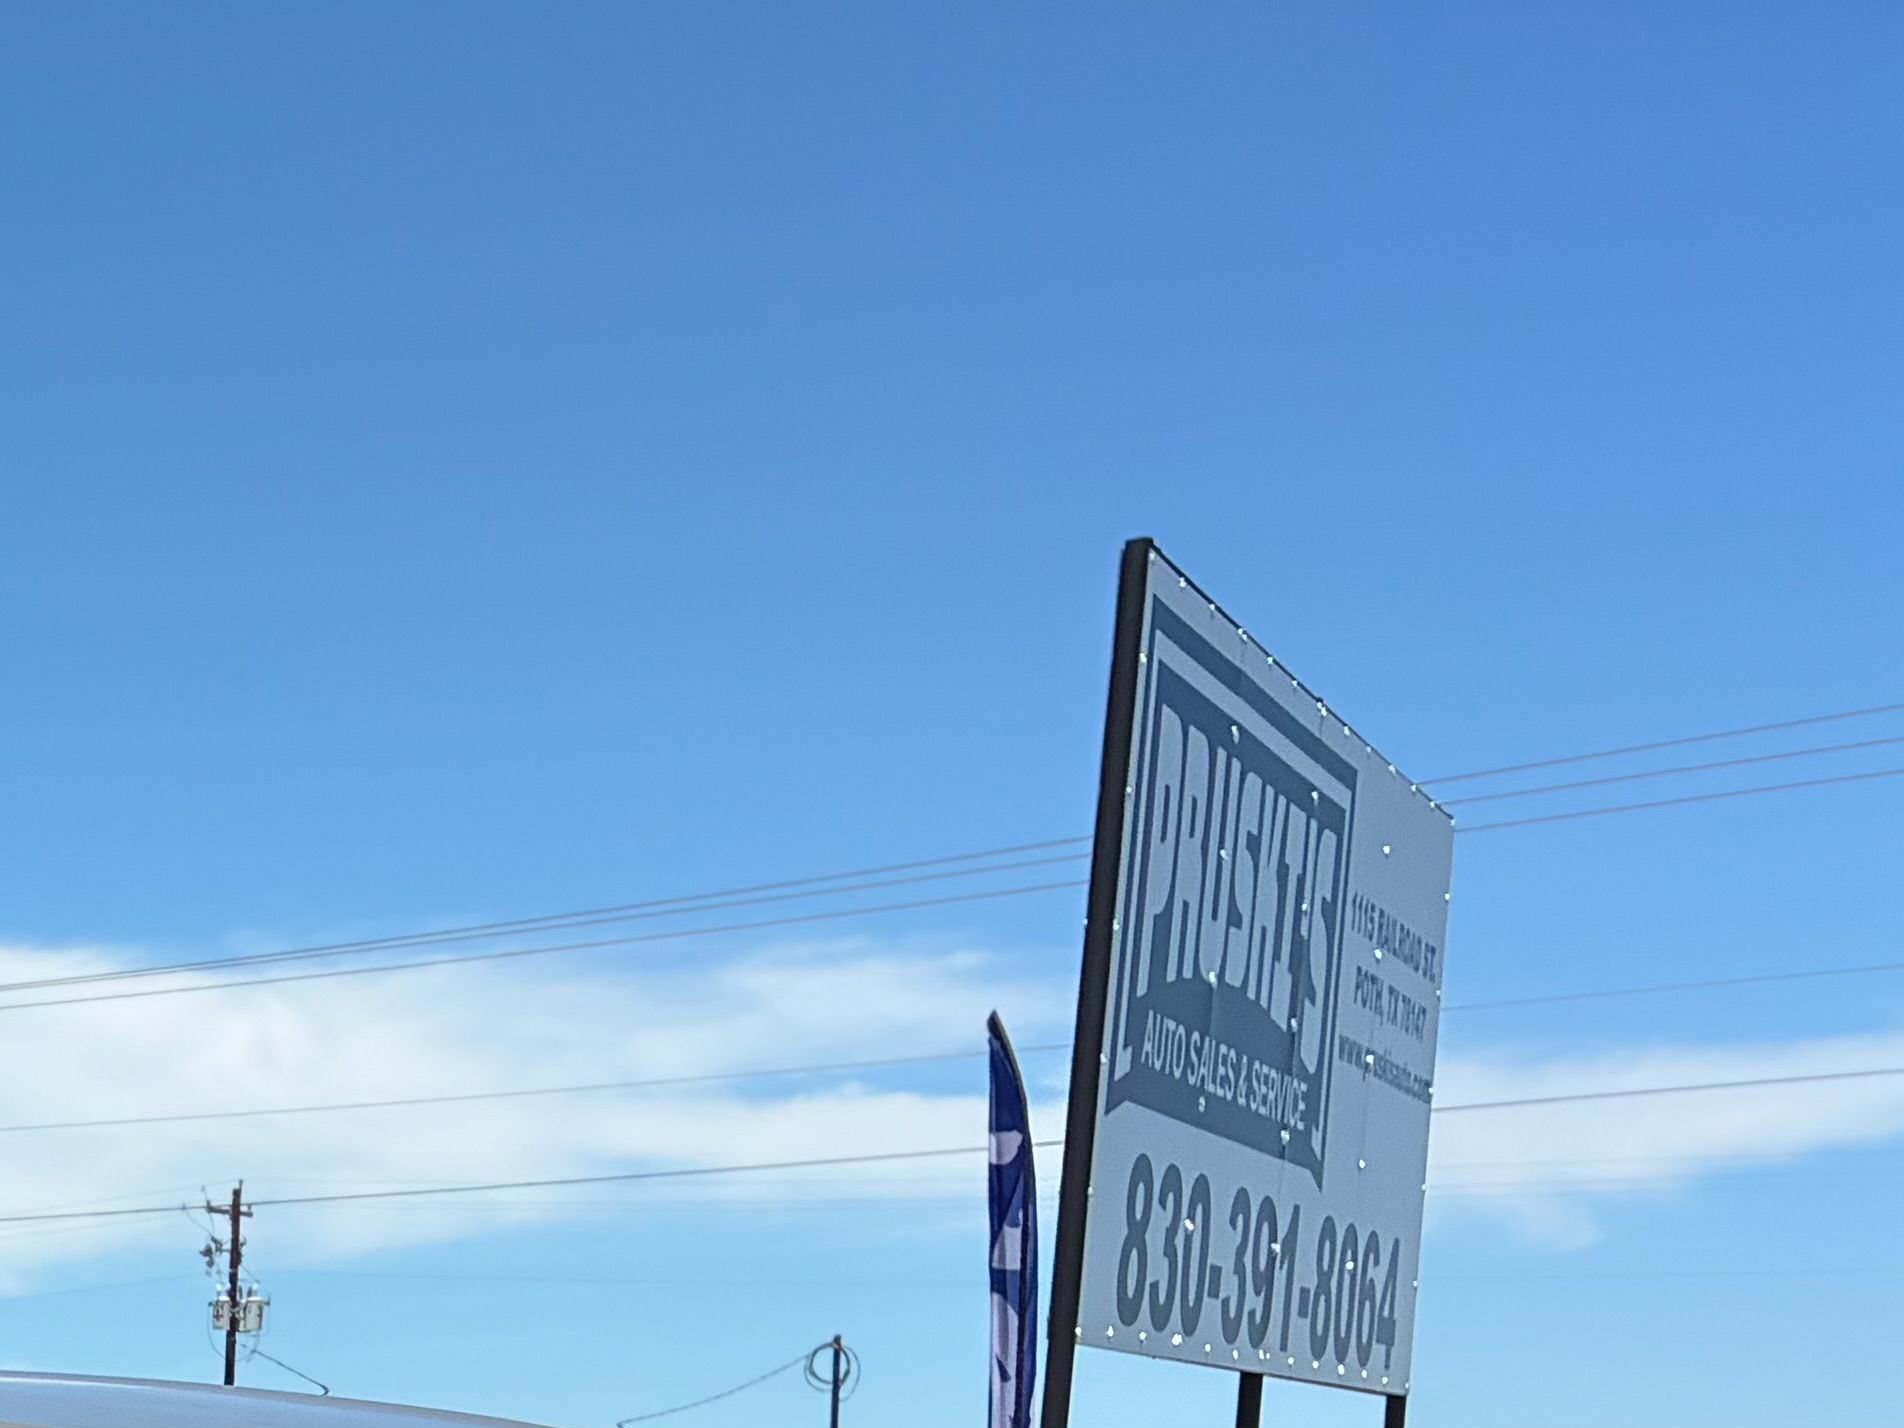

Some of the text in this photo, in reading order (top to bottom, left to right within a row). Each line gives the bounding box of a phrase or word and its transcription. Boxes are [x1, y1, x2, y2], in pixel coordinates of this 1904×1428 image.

[1135, 703, 1338, 1074] PRUSKI'S
[1351, 891, 1376, 942] 1115
[1140, 1009, 1308, 1131] AUTO SALES & SERVICE
[1116, 1152, 1401, 1371] 830-391-8064
